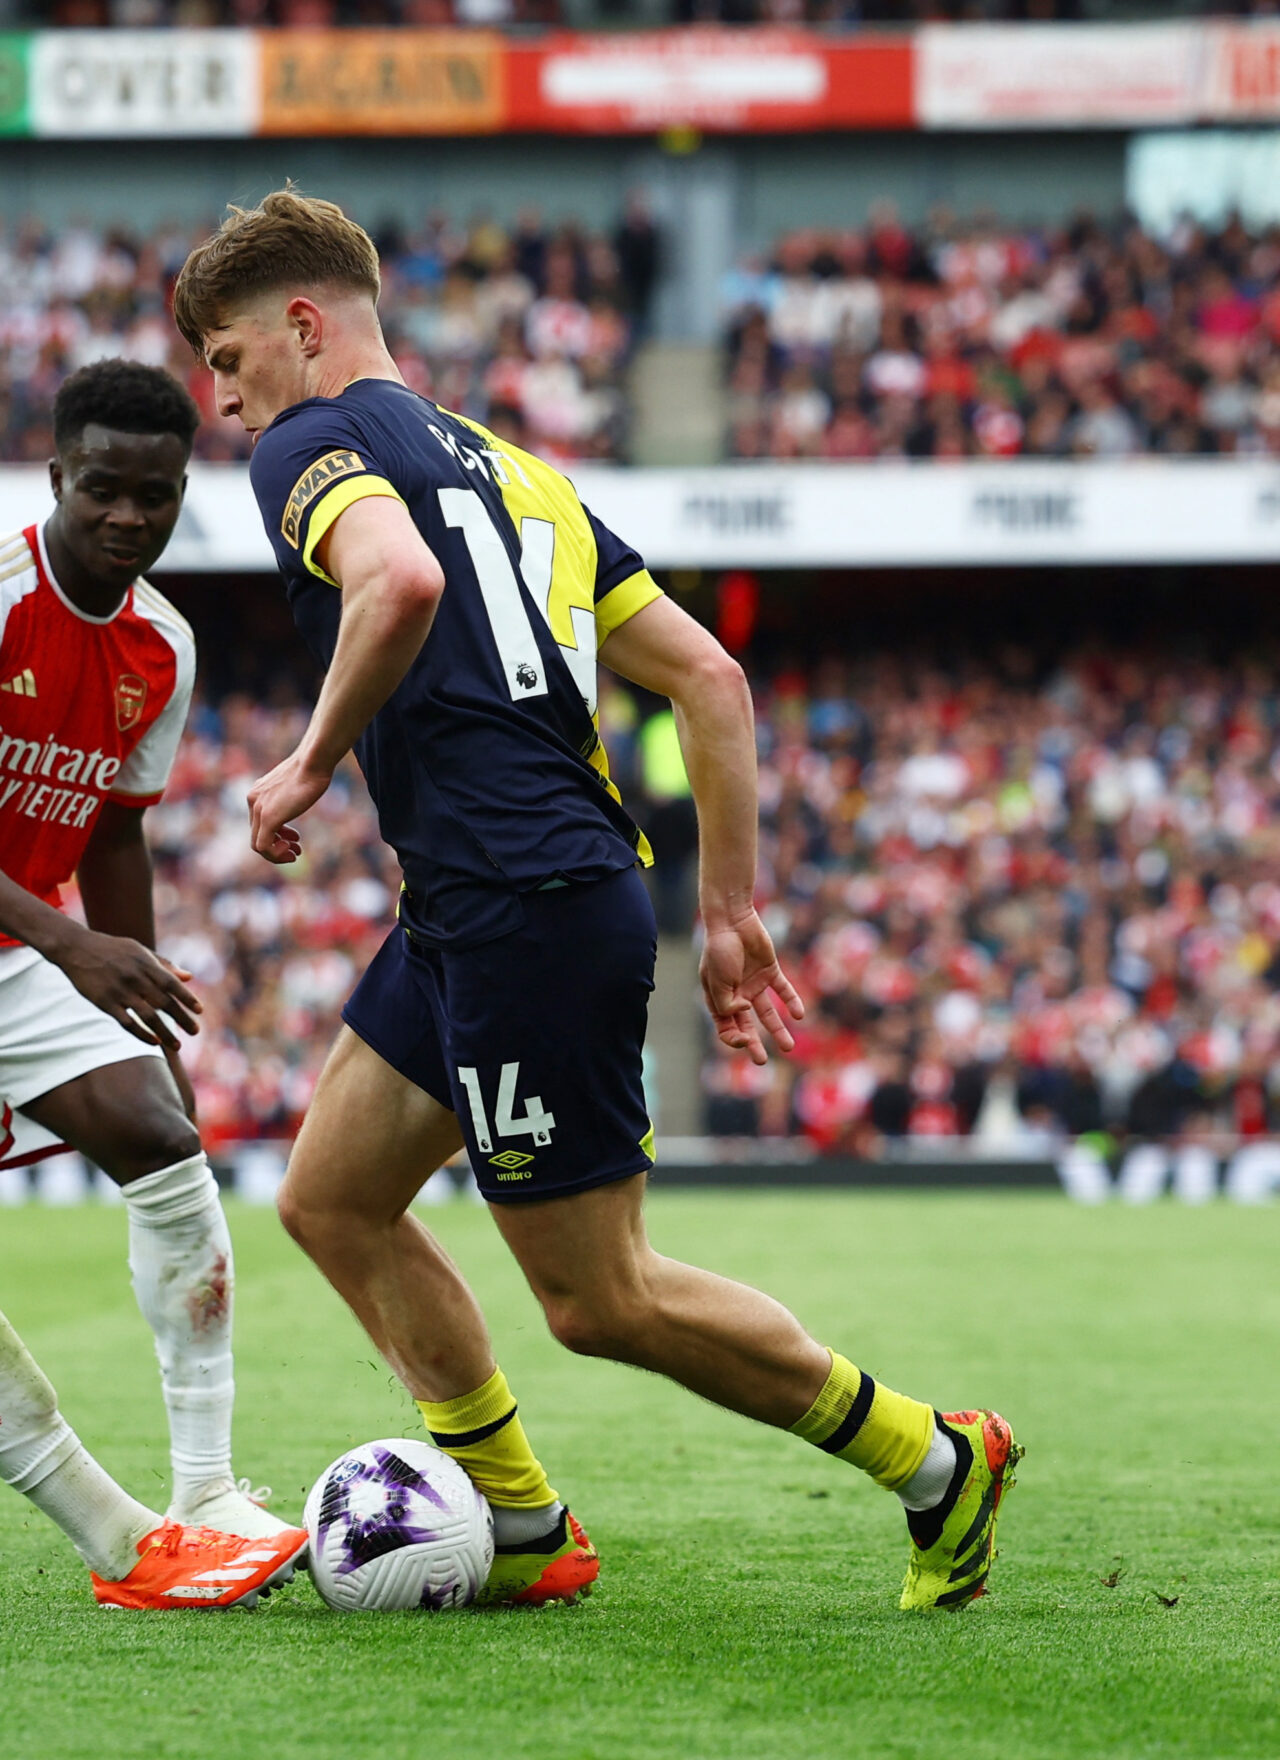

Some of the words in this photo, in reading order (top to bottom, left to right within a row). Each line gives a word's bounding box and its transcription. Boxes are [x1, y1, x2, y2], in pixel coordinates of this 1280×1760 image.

[52, 55, 234, 111] OVER
[275, 53, 488, 109] AGAIN
[436, 486, 597, 718] 14
[457, 1061, 557, 1153] 14
[496, 1170, 533, 1182] umbro
